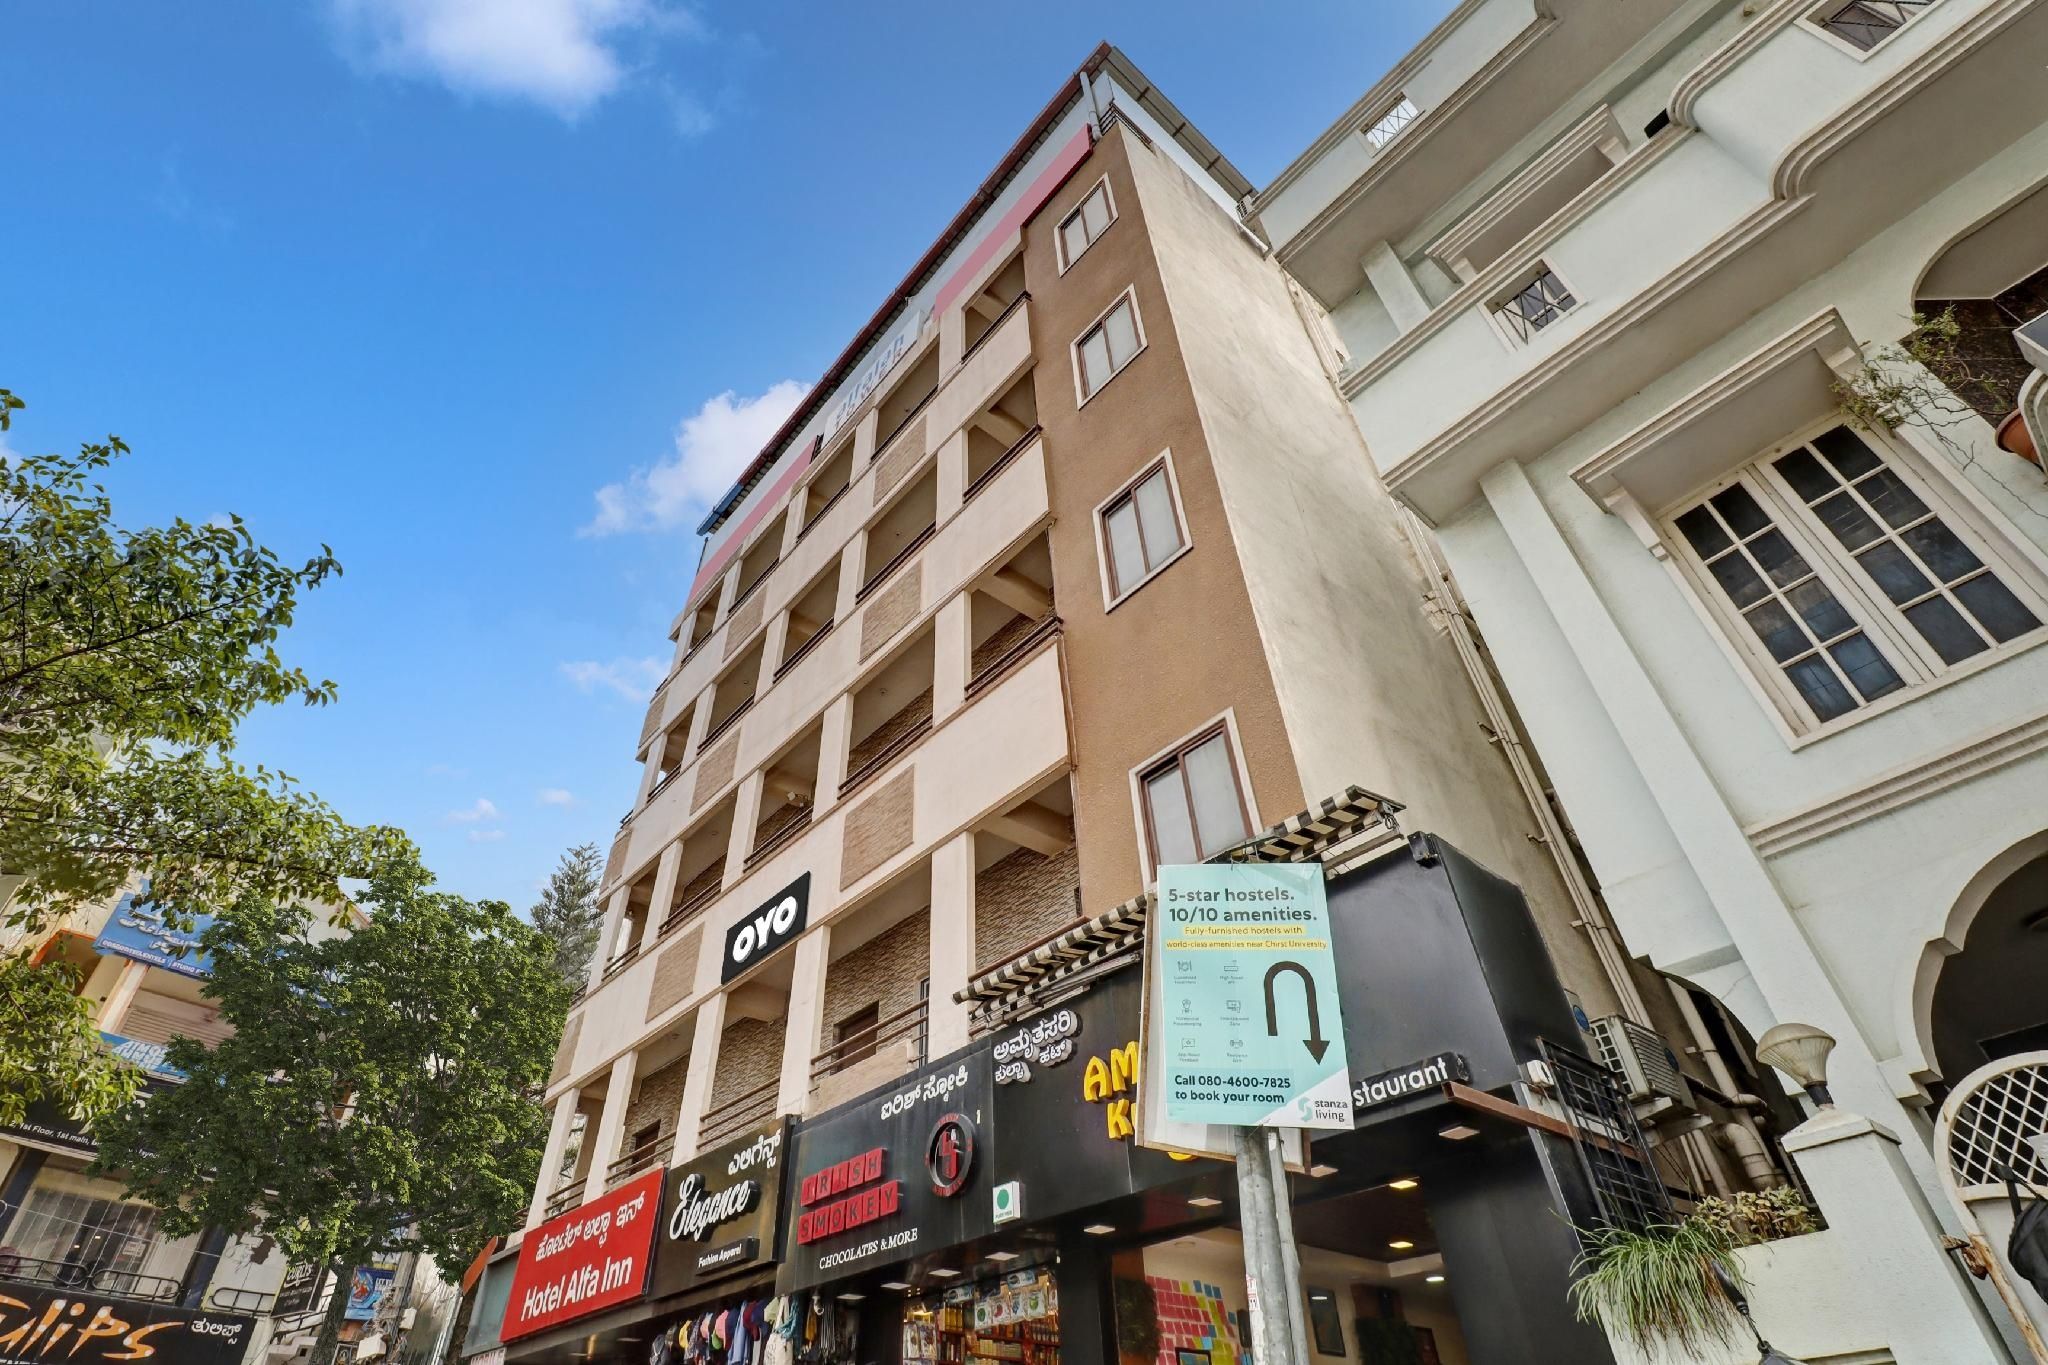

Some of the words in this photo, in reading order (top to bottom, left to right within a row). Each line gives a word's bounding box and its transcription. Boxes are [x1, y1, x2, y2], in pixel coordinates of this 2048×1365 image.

[1168, 888, 1221, 902] 5-star
[1224, 887, 1295, 901] hostels.
[1169, 908, 1218, 923] 10/10
[1223, 907, 1318, 922] amenities.
[732, 896, 798, 963] OYO
[1250, 926, 1281, 935] hostels
[1283, 926, 1303, 935] with
[1209, 940, 1245, 949] amenities
[1246, 941, 1263, 949] near
[1288, 940, 1327, 950] University
[1174, 1075, 1195, 1086] Call
[1198, 1075, 1291, 1089] 080-4600-7825
[1352, 1057, 1449, 1107] staurant
[1175, 1091, 1187, 1100] to
[1190, 1090, 1220, 1101] book
[1222, 1093, 1249, 1104] your
[1252, 1094, 1285, 1103] room
[1314, 1100, 1348, 1109] stanza
[1315, 1110, 1345, 1122] living
[803, 1152, 881, 1204] IRISH
[669, 1173, 752, 1242] Elegance
[800, 1184, 896, 1241] SMOKEY
[819, 1239, 878, 1270] CHOCOLATES
[520, 1274, 566, 1322] Hotel
[563, 1263, 600, 1306] Alfa
[600, 1256, 633, 1293] Inn
